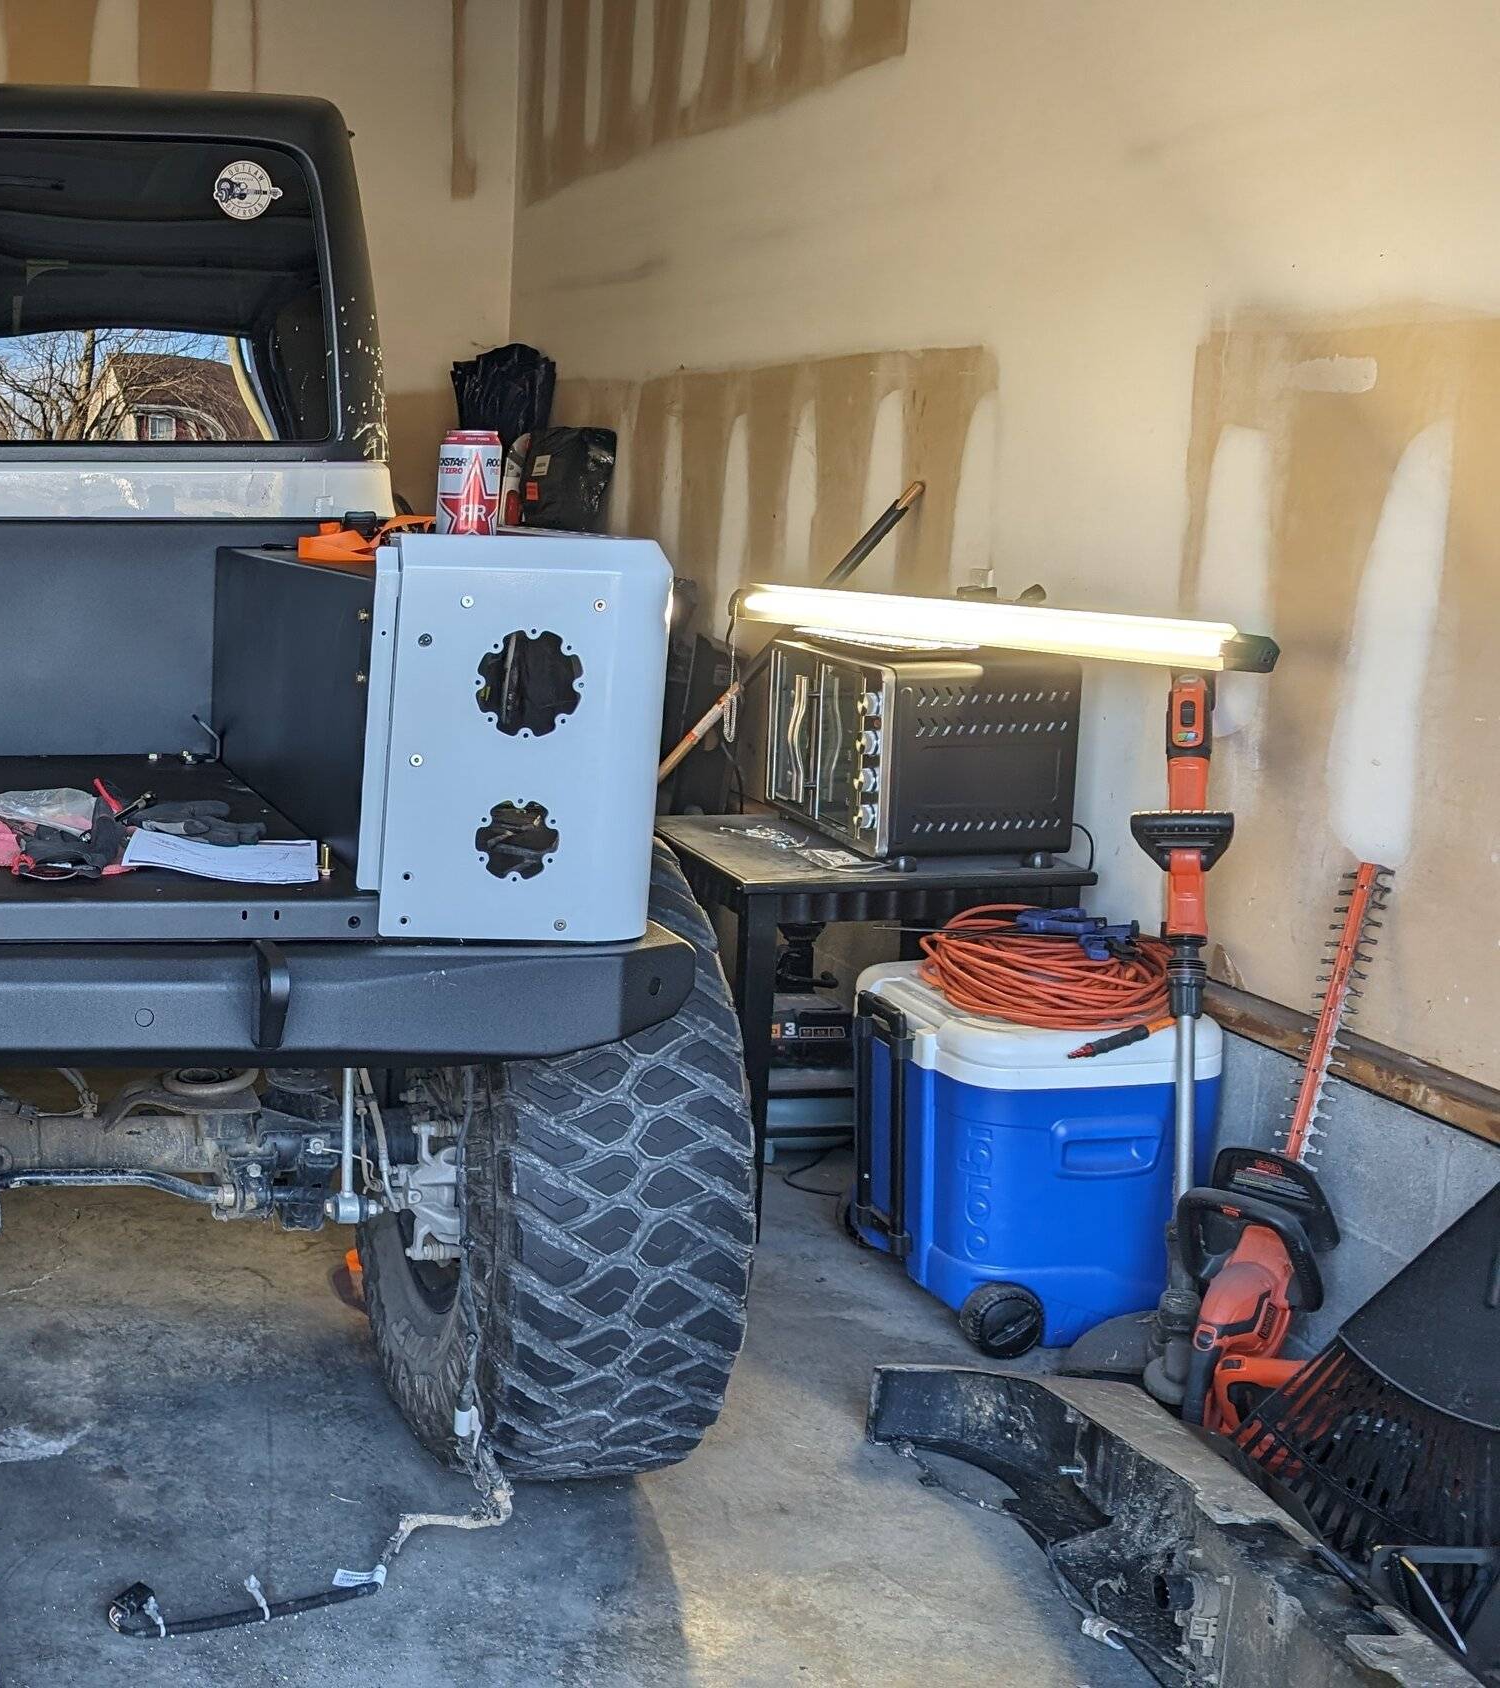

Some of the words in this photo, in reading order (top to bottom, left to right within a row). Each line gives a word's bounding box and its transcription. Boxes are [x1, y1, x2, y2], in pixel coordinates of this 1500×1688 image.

[228, 165, 266, 180] OUTLAW
[226, 203, 263, 215] OFFROAD
[784, 1022, 796, 1036] 3
[957, 1126, 993, 1261] igloo
